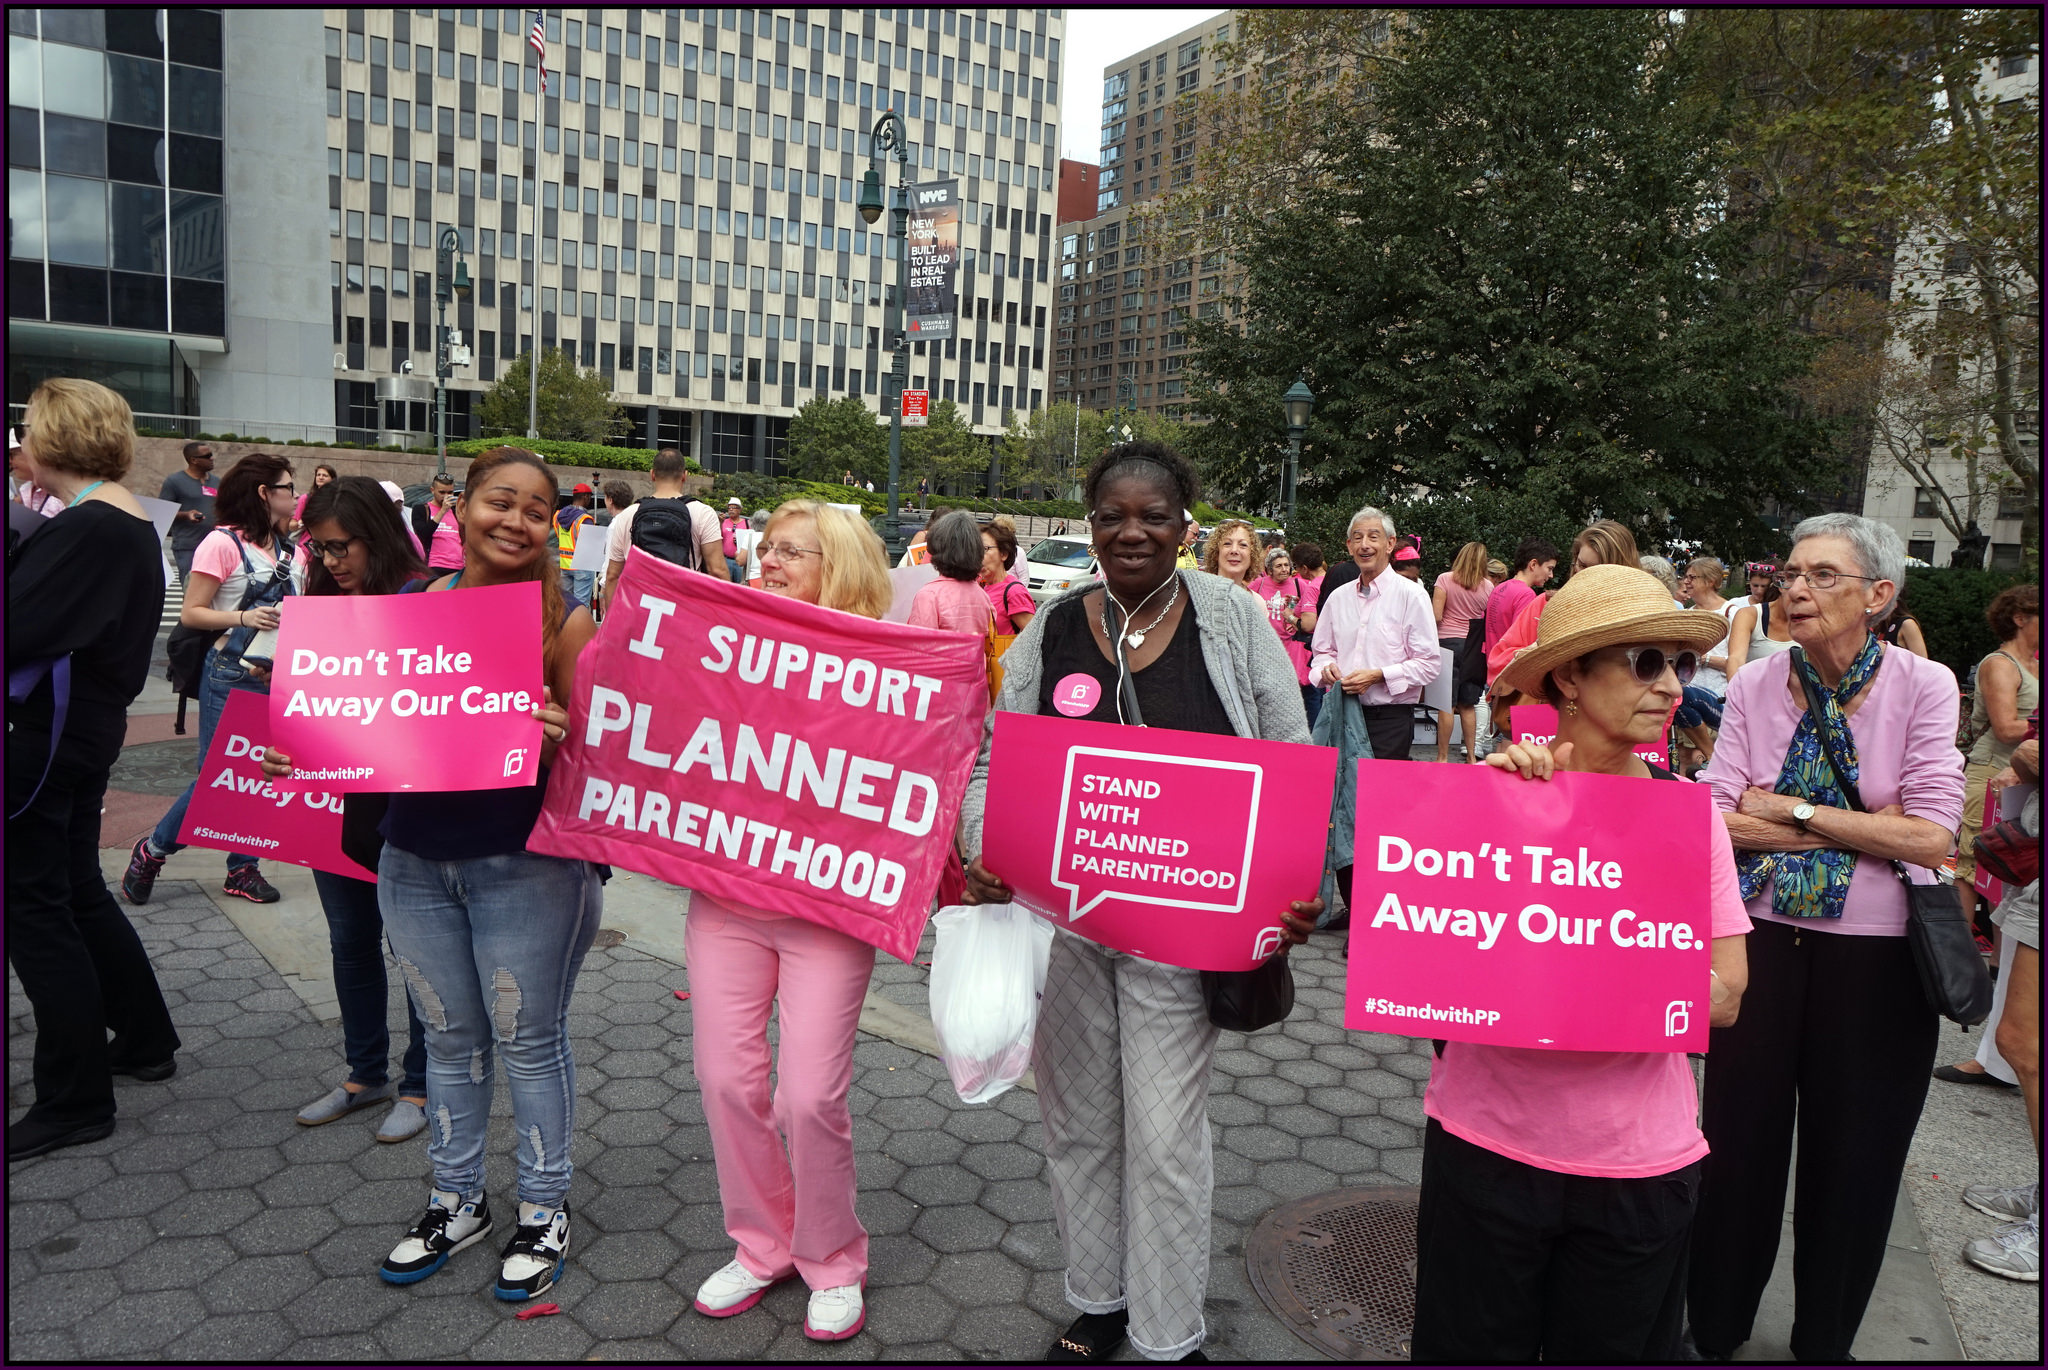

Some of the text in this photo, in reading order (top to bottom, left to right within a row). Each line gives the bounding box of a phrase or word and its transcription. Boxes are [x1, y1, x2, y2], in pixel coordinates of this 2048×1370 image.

[920, 189, 947, 203] NYC
[911, 229, 939, 240] YORK.
[912, 218, 934, 229] NEW
[911, 245, 936, 256] BUILT
[911, 254, 950, 266] TO LEAD
[911, 265, 946, 277] IN REAL
[911, 276, 944, 288] ESTATE.
[290, 645, 472, 676] Don't Take
[628, 593, 942, 721] I SUPPORT
[283, 685, 539, 725] Away Our Care.
[585, 684, 939, 837] PLANNED
[1081, 774, 1161, 799] STAND
[1078, 801, 1140, 825] WITH
[193, 826, 280, 850] #StandwithPP
[578, 776, 907, 907] PARENTHOOD
[1074, 828, 1189, 858] PLANNED
[1071, 853, 1236, 890] PARENTHOOD
[1376, 835, 1623, 889] Don't Take
[1370, 892, 1704, 951] Away Our Care.
[1365, 997, 1501, 1026] #StandwithPP
